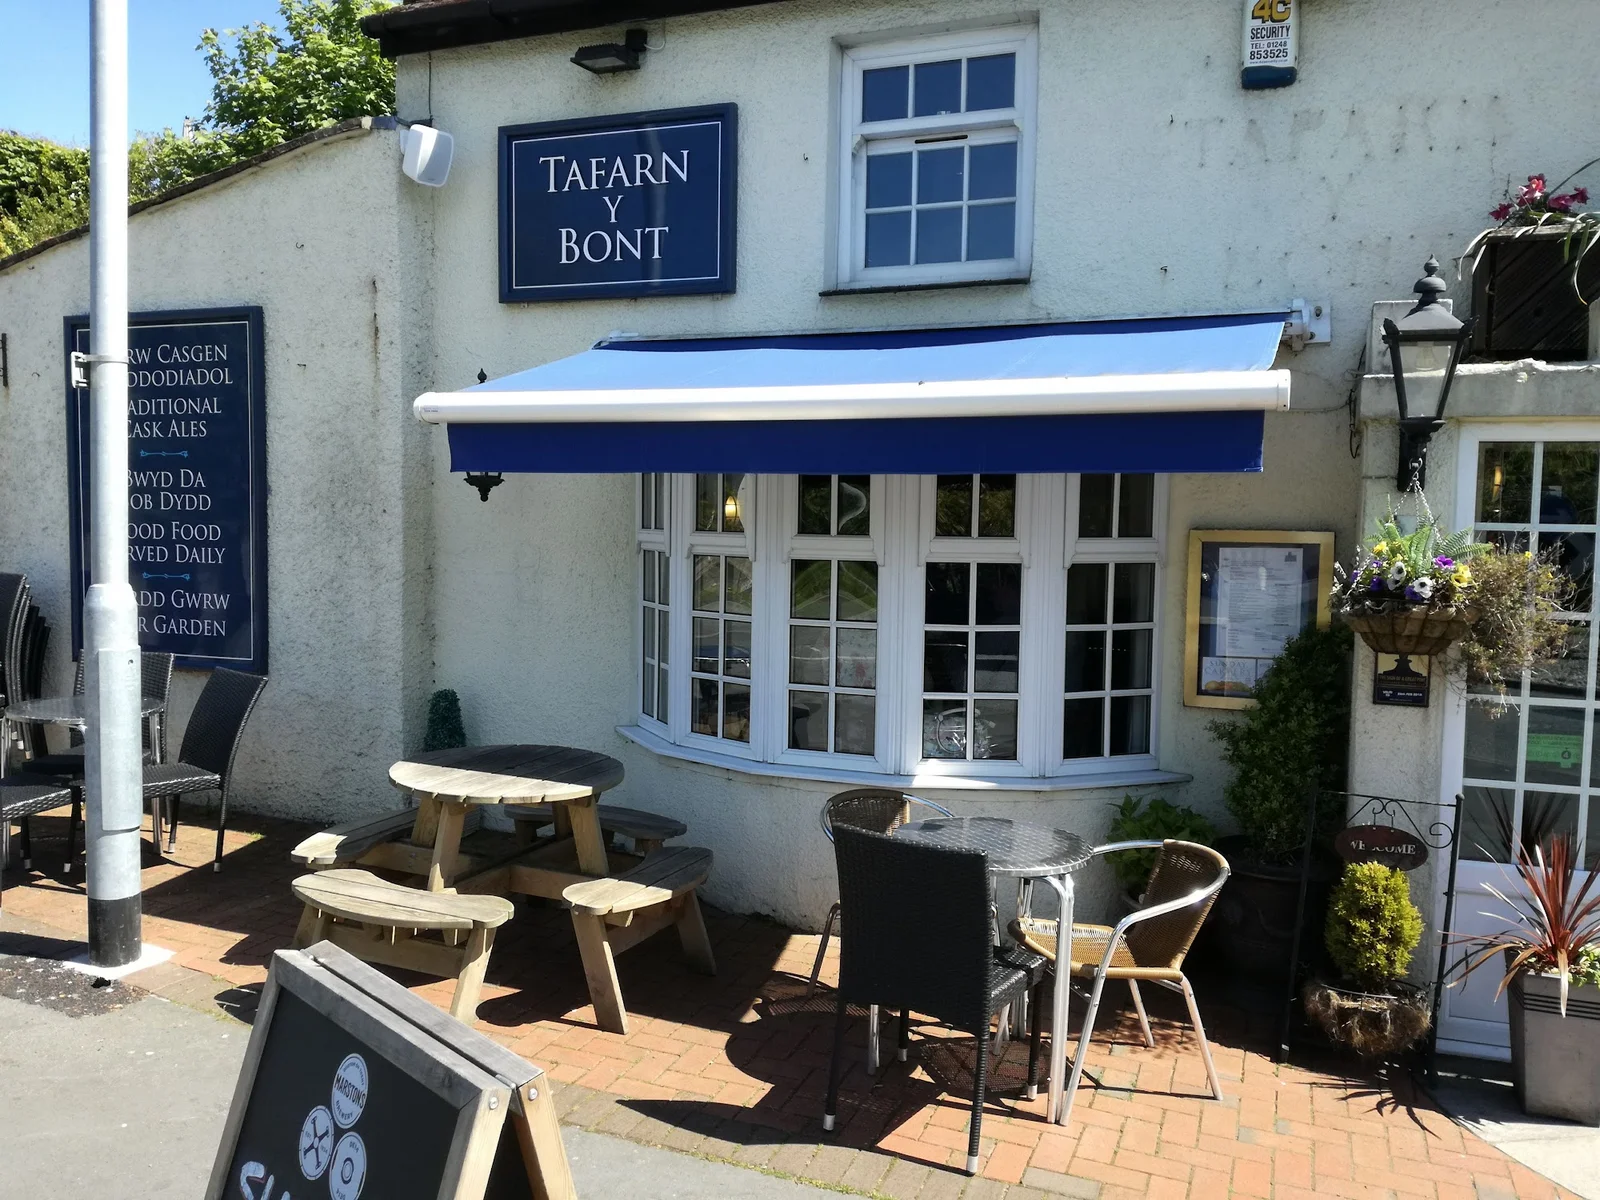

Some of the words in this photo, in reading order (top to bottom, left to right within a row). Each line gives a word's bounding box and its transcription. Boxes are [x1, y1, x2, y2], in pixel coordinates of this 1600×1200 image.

[1251, 0, 1292, 24] 4C
[1250, 25, 1291, 40] SECURITY
[1249, 48, 1289, 60] 853525
[1250, 42, 1265, 50] TEL:
[1266, 41, 1288, 49] 01248
[539, 150, 690, 193] TAFARN
[602, 195, 624, 223] Y
[558, 226, 669, 264] BONT
[127, 347, 152, 364] RW
[157, 344, 228, 364] CASGEN
[127, 397, 223, 416] ADITIONAL
[127, 420, 165, 439] ASK
[167, 419, 208, 438] ALES
[180, 469, 207, 488] DA
[130, 493, 153, 511] OB
[160, 492, 212, 512] DYDD
[128, 523, 165, 540] OOD
[171, 521, 222, 541] FOOD
[128, 545, 169, 562] RVED
[175, 544, 226, 564] DAILY
[171, 589, 231, 610] GWRW
[153, 614, 227, 637] GARDEN
